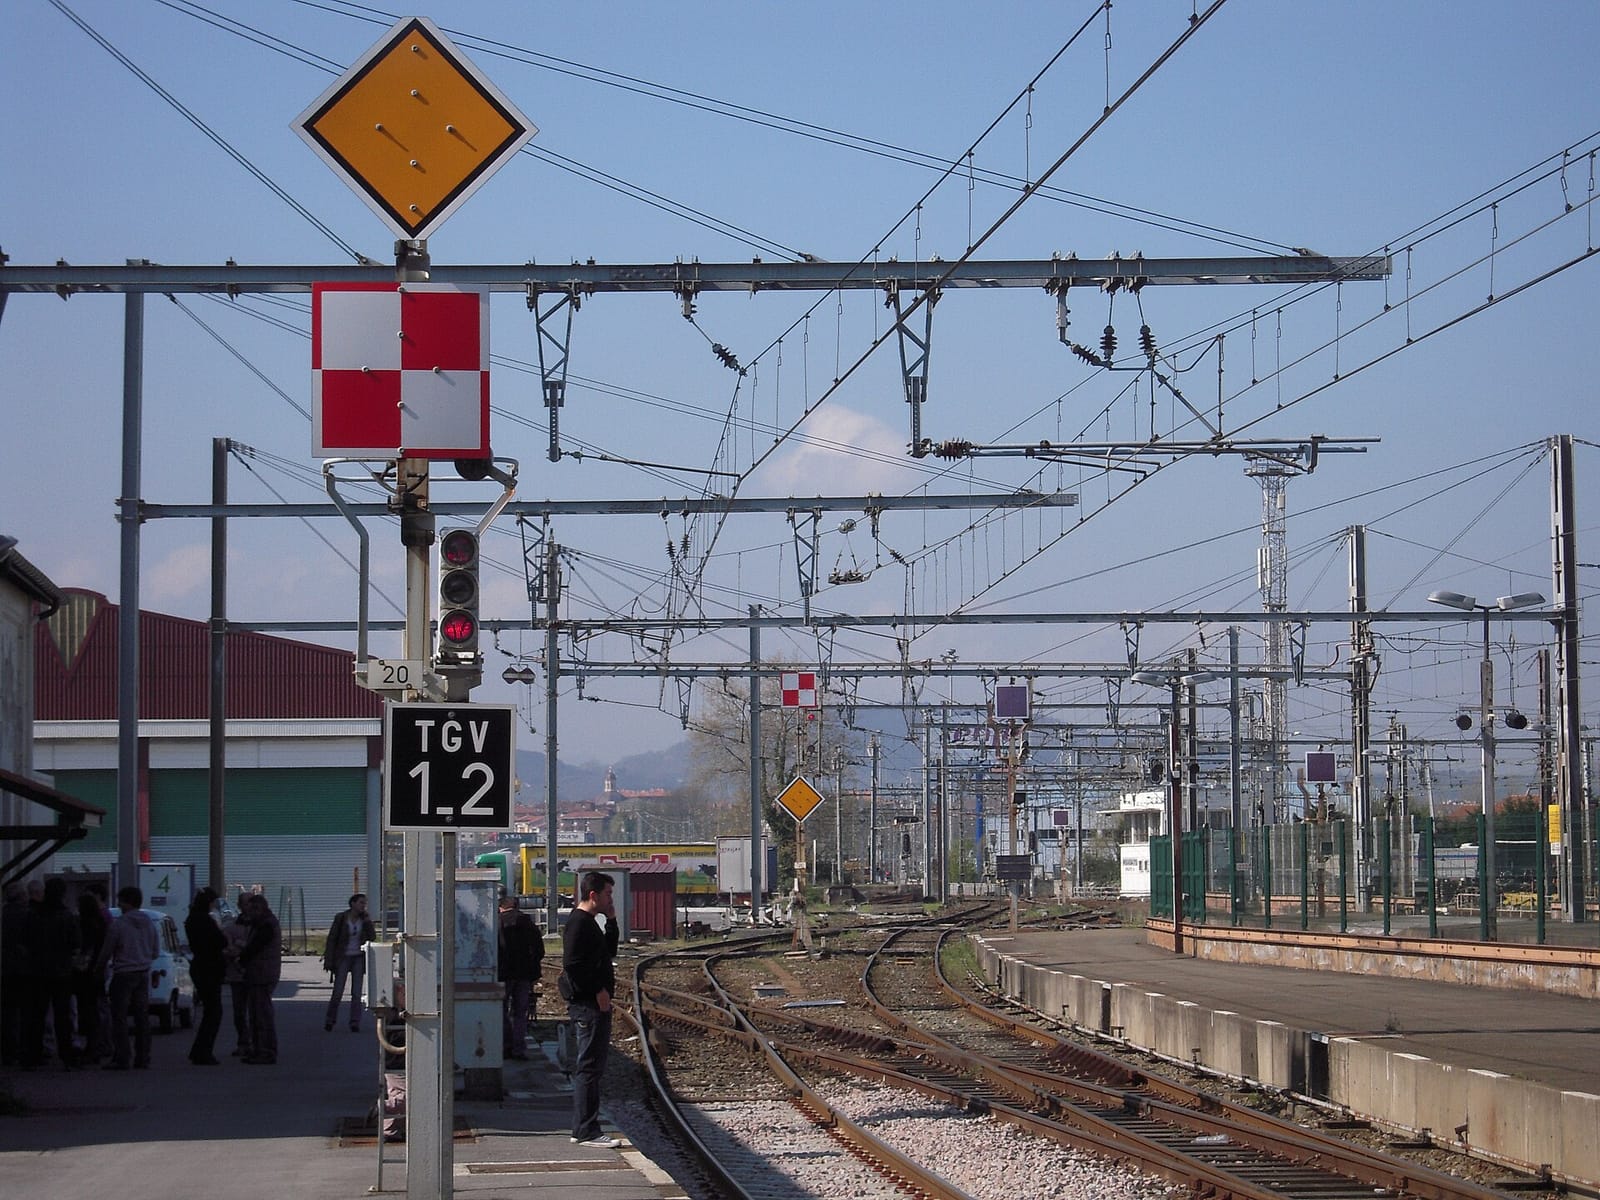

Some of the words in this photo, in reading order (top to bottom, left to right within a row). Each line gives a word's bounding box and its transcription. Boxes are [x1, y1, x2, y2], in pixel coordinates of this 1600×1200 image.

[382, 665, 409, 684] 20
[415, 720, 489, 753] TGV
[620, 851, 649, 859] LECHE
[157, 874, 171, 893] 4
